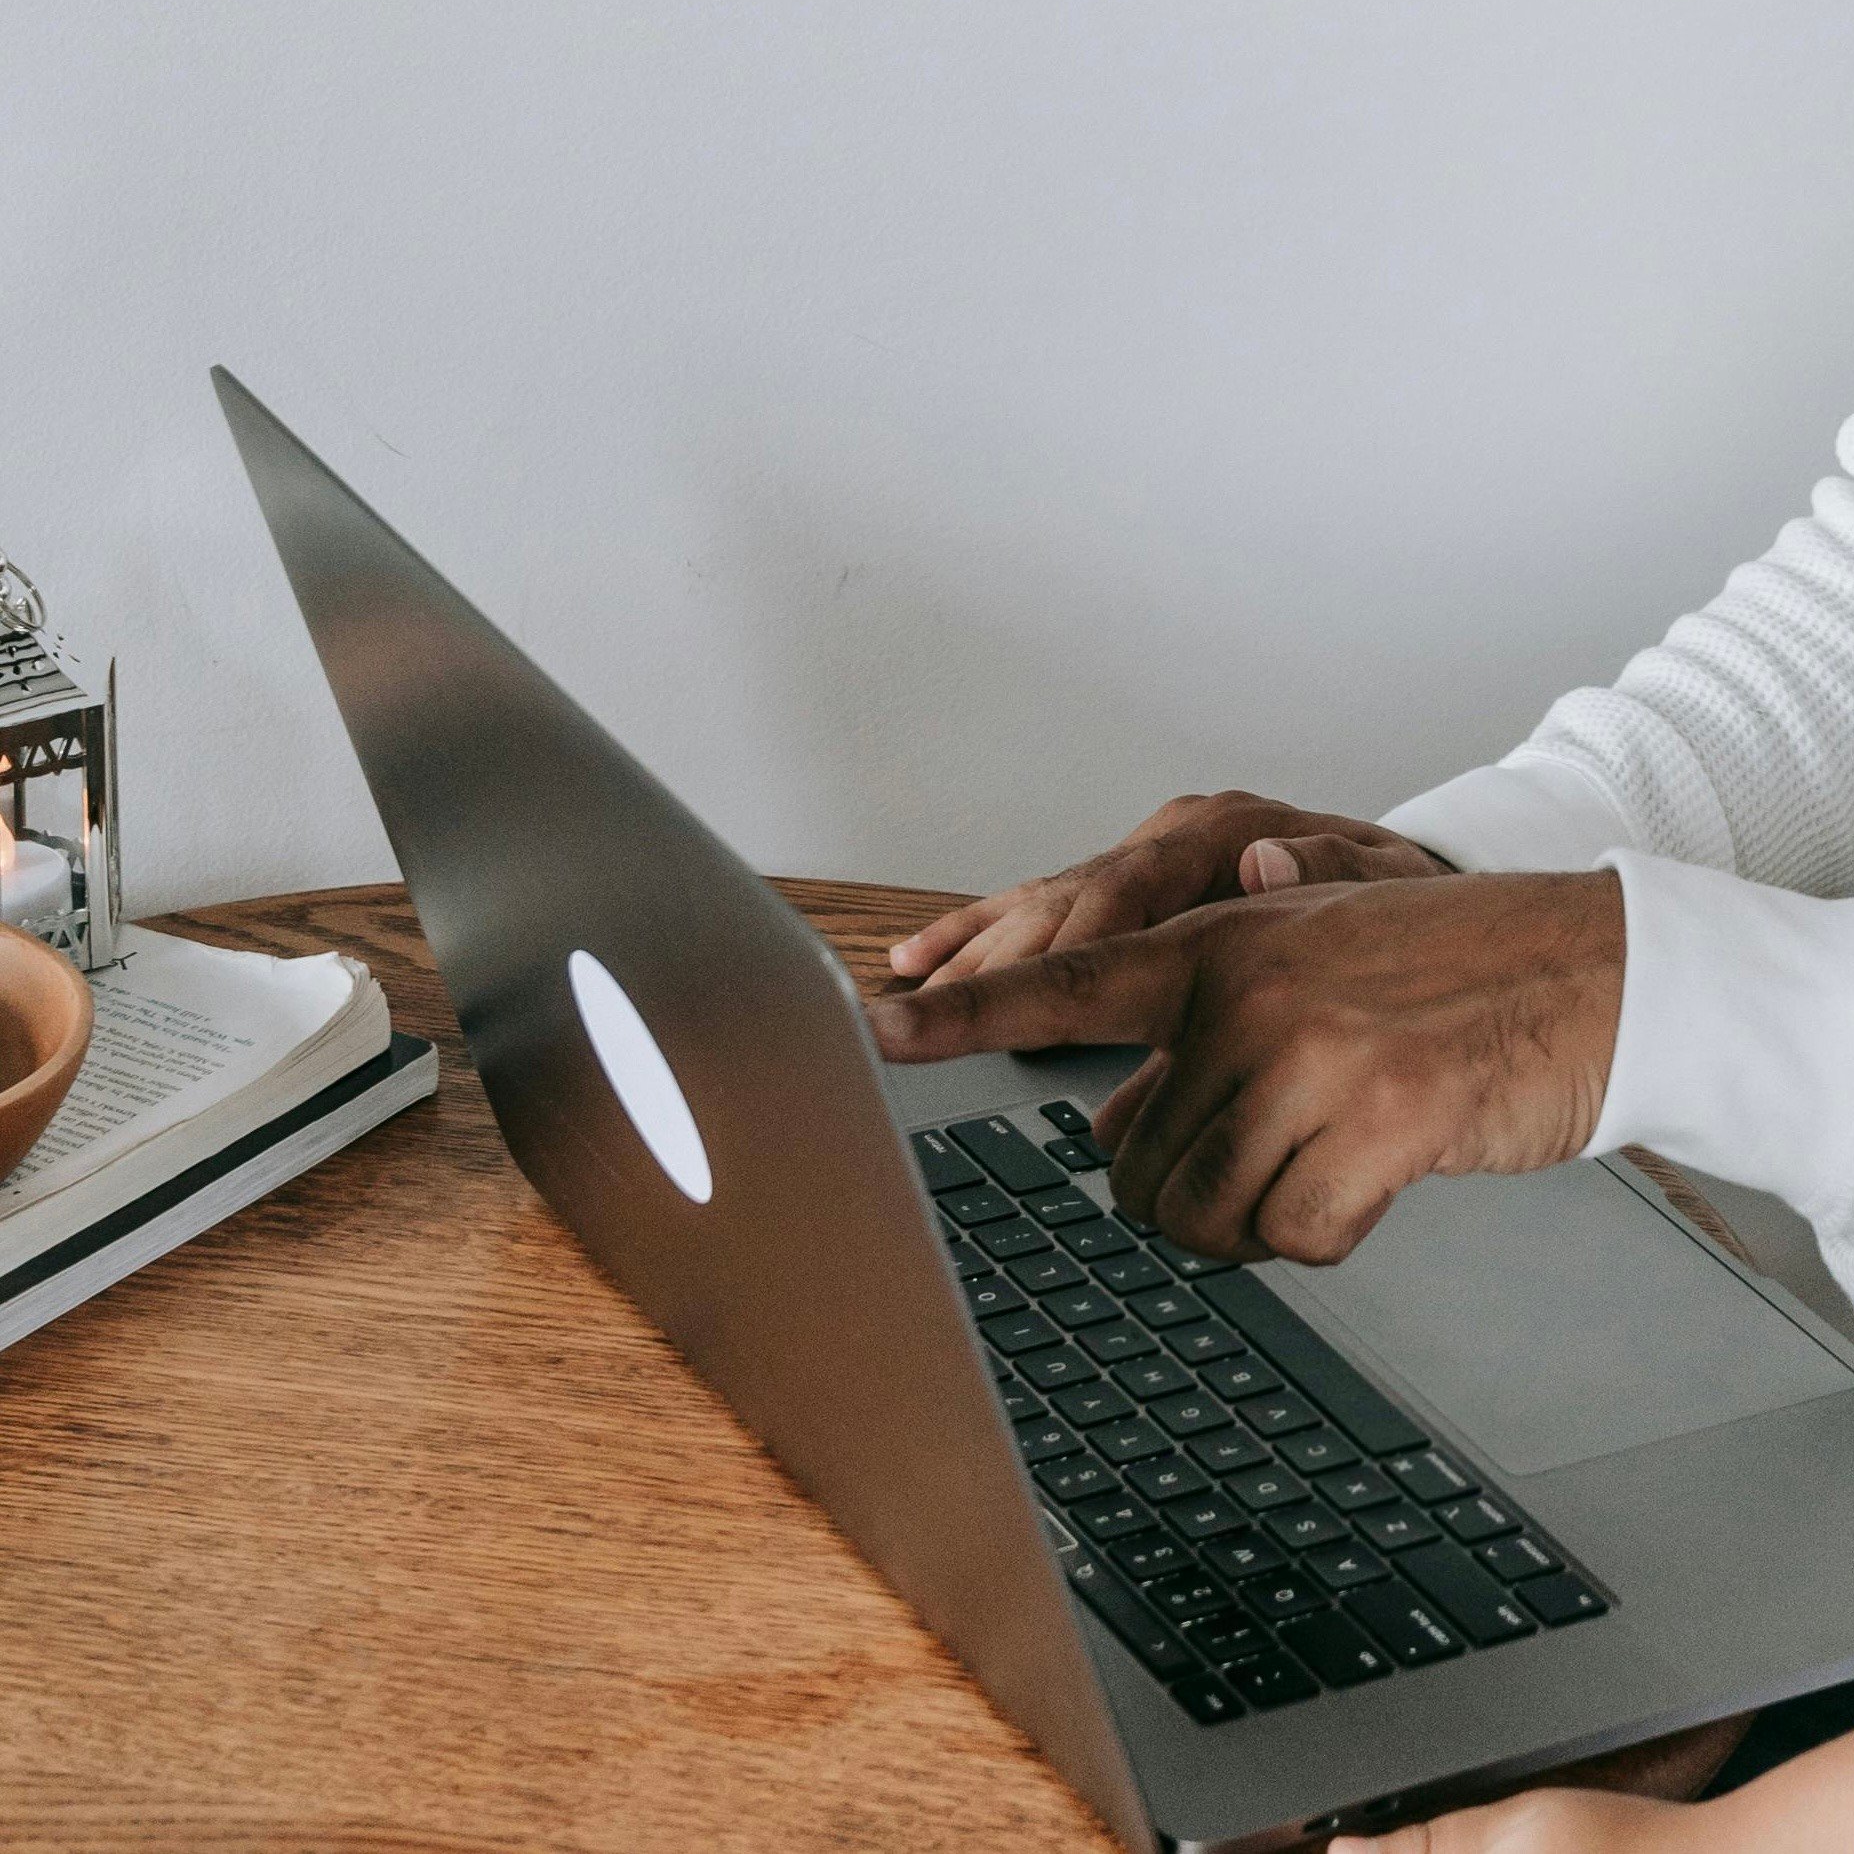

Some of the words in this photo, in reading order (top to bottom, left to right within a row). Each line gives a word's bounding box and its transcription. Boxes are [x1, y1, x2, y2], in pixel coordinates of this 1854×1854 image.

[923, 1134, 946, 1154] return
[1039, 1266, 1057, 1277] L
[977, 1291, 997, 1302] O
[1072, 1301, 1091, 1312] K
[1156, 1300, 1177, 1313] M
[1107, 1335, 1127, 1343] J
[1194, 1335, 1214, 1348] N
[1046, 1361, 1067, 1373] U
[1143, 1370, 1163, 1383] H
[1231, 1371, 1252, 1384] B
[1004, 1395, 1024, 1405] 7
[1083, 1399, 1102, 1409] Y
[1180, 1407, 1201, 1419] G
[1268, 1409, 1287, 1420] V
[1041, 1432, 1061, 1443] 6
[1119, 1436, 1138, 1446] T
[1218, 1446, 1239, 1456] F
[1306, 1444, 1328, 1457] C
[1078, 1469, 1098, 1481] 5
[1157, 1472, 1178, 1485] R
[1257, 1481, 1278, 1494] D
[1346, 1482, 1367, 1494] X
[1115, 1508, 1133, 1518] 4
[1195, 1510, 1216, 1523] E
[1295, 1520, 1317, 1533] S
[1385, 1520, 1408, 1533] Z
[1337, 1558, 1357, 1571] A
[1274, 1588, 1295, 1602] Q
